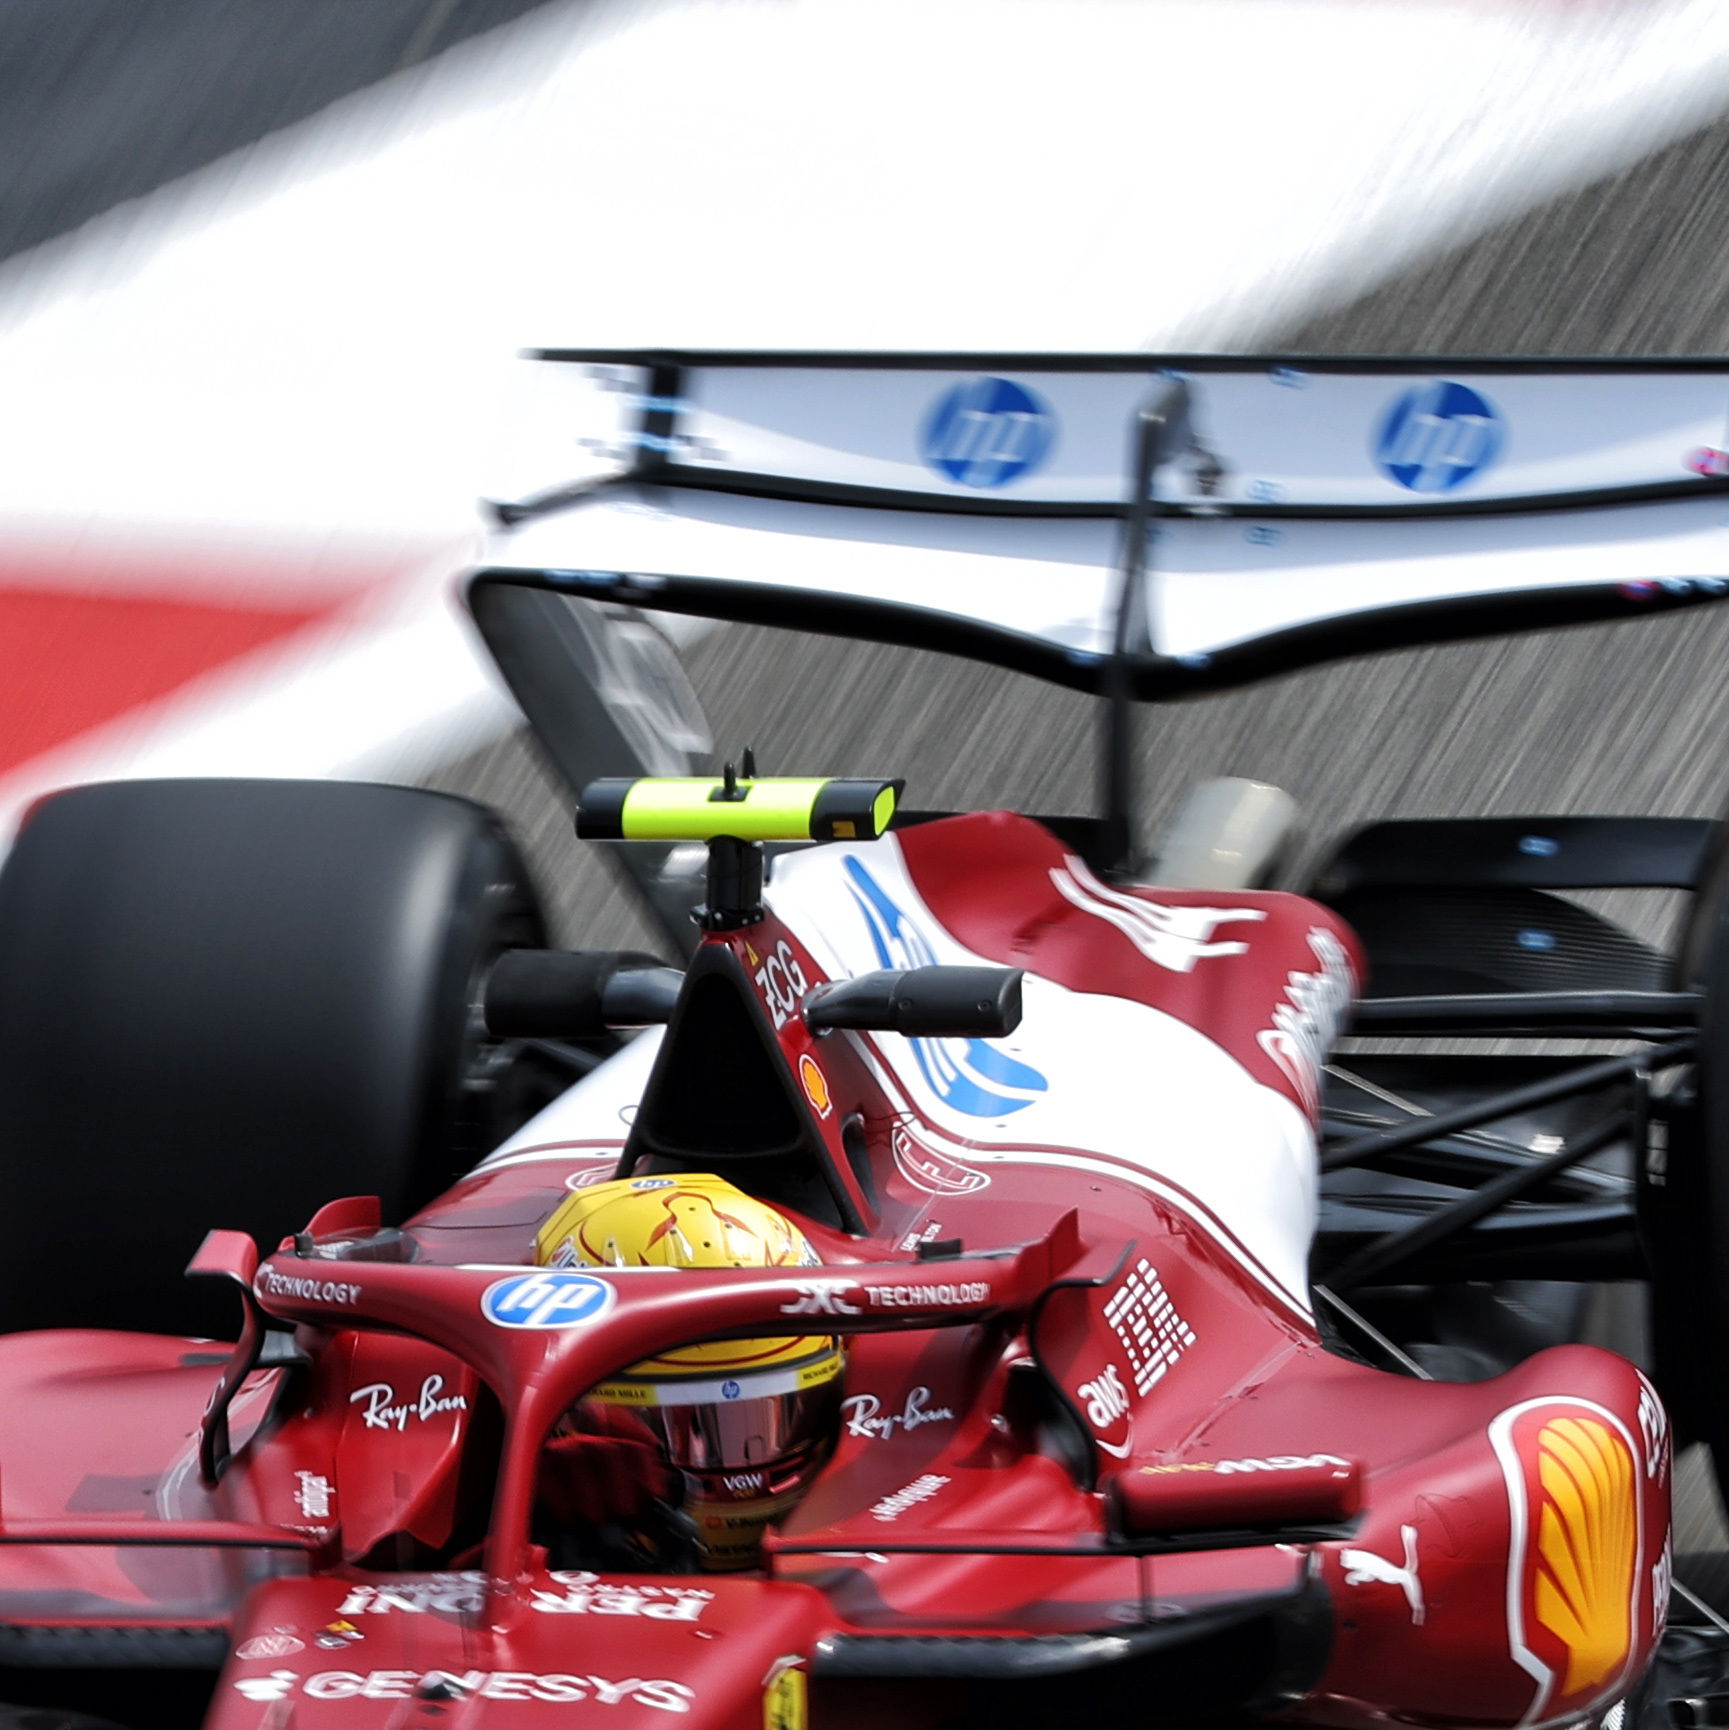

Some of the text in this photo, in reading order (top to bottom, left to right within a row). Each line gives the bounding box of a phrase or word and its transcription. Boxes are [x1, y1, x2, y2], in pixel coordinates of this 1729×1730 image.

[755, 940, 808, 1030] ZCG
[265, 1272, 361, 1305] TECHNOLOGY
[492, 1272, 605, 1327] hp
[1103, 1258, 1198, 1397] IBM
[722, 1380, 740, 1399] hp
[1077, 1364, 1130, 1429] aws
[723, 1473, 763, 1491] VGW
[302, 1669, 694, 1713] GENESYS
